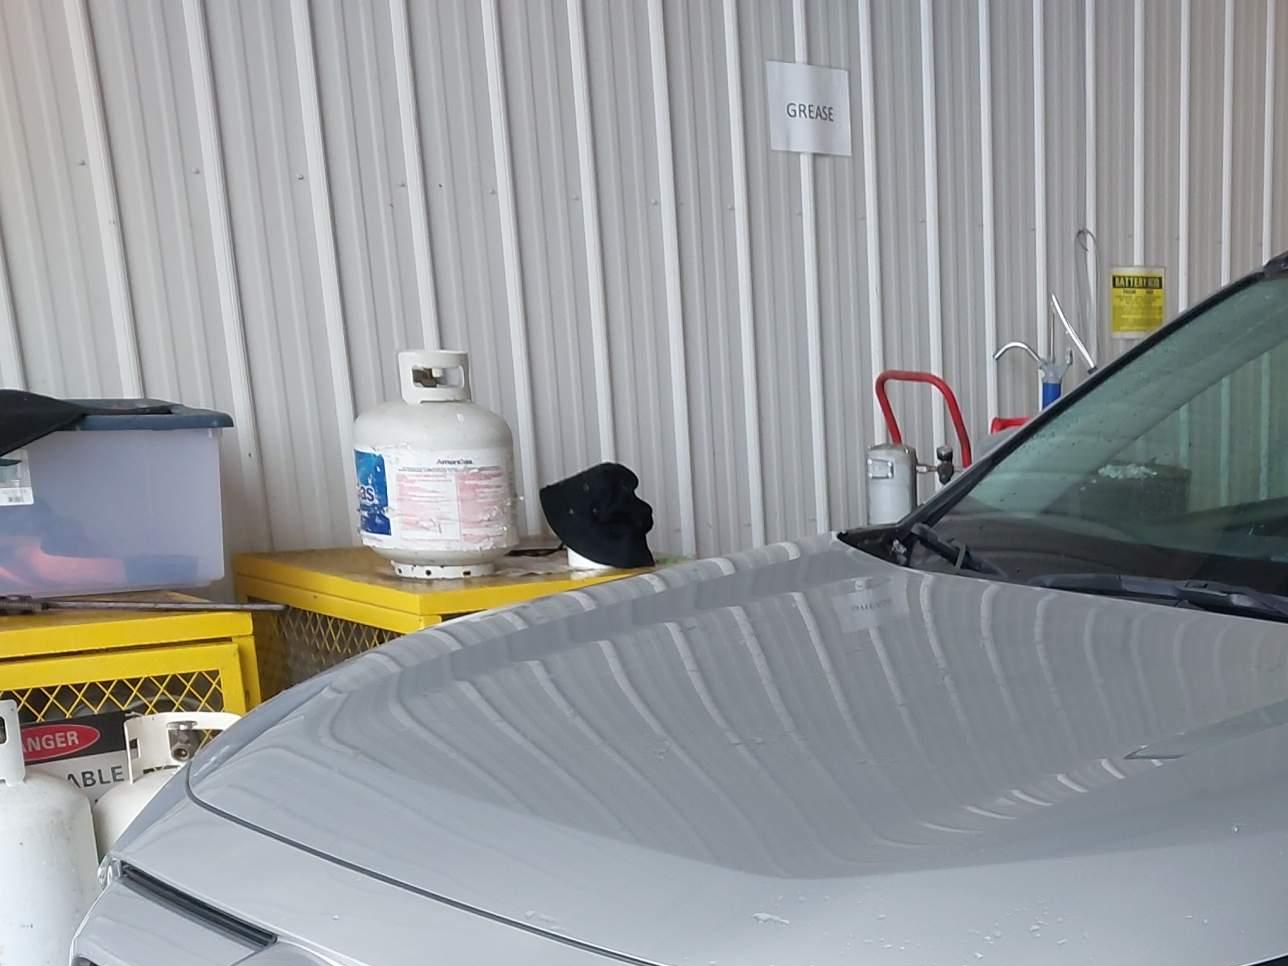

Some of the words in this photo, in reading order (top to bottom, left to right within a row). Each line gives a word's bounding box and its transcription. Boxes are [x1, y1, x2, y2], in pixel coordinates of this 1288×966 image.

[786, 102, 834, 122] GREASE
[359, 486, 375, 502] as
[24, 731, 79, 752] NGER
[67, 766, 125, 788] ABLE
